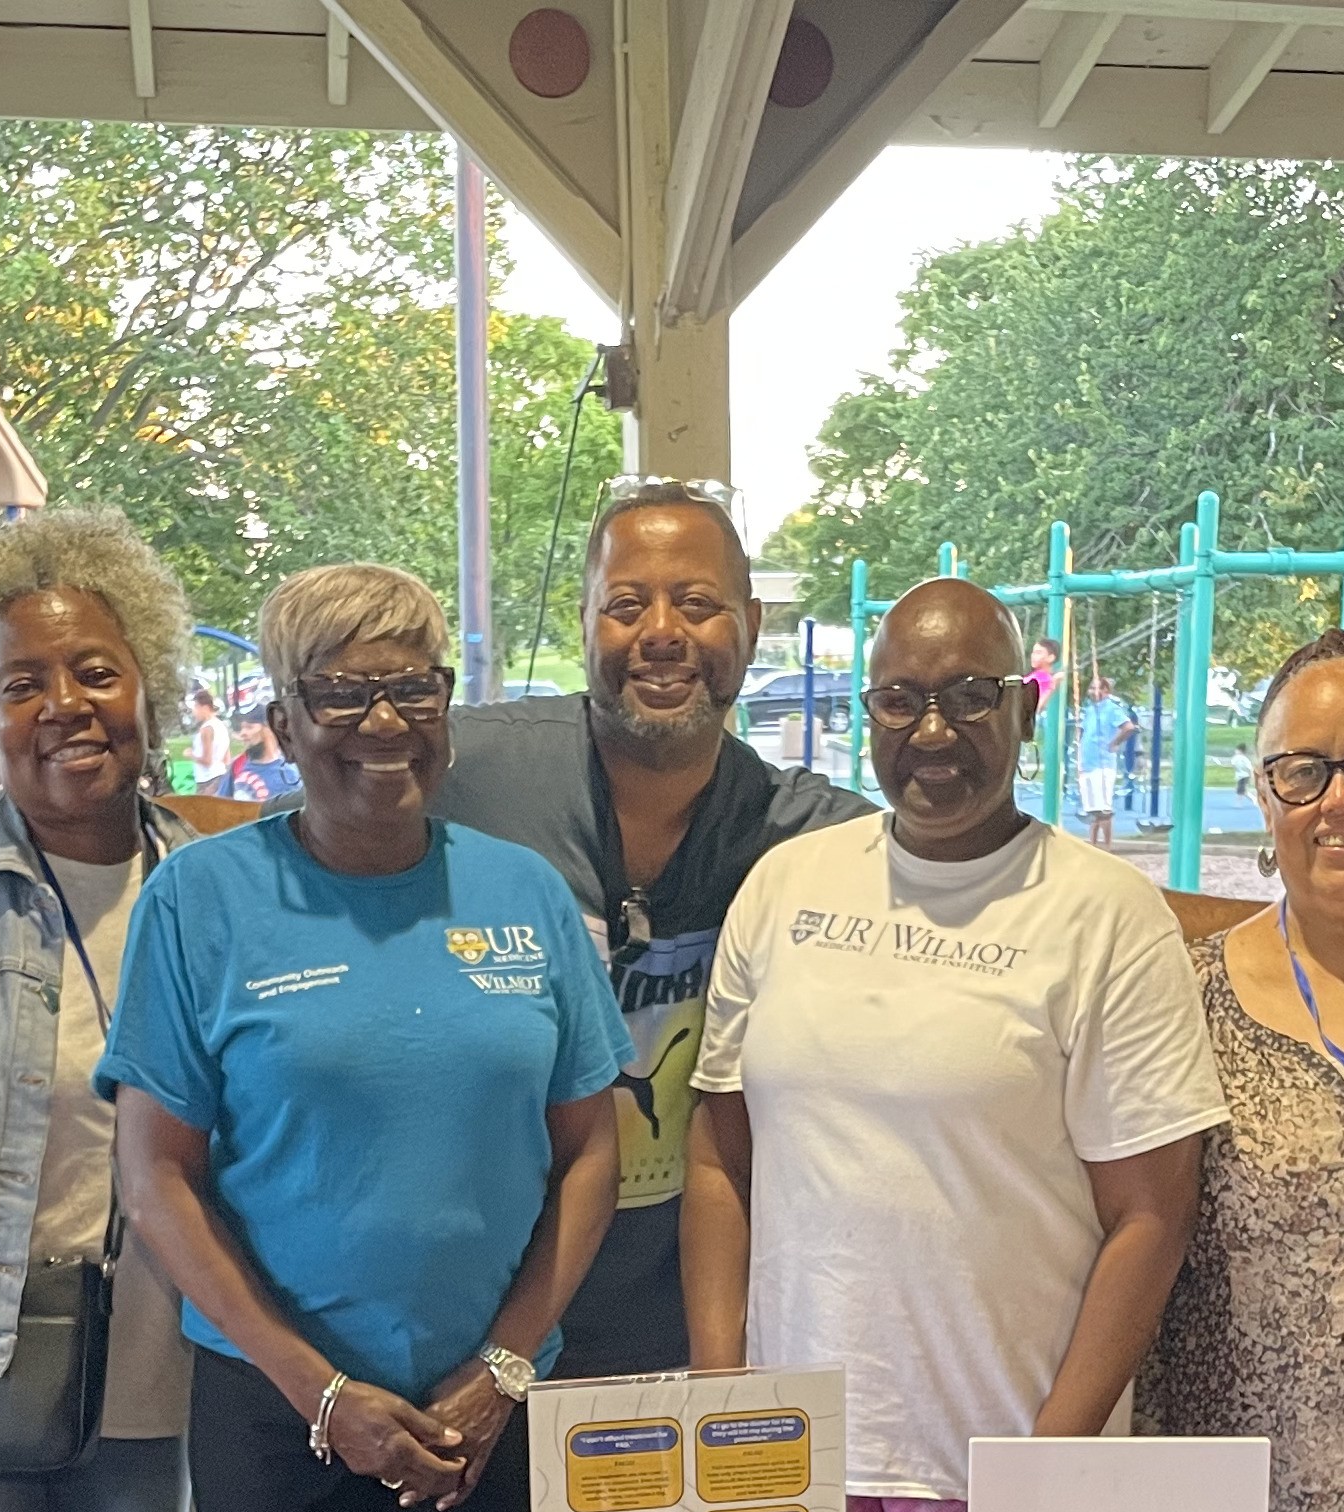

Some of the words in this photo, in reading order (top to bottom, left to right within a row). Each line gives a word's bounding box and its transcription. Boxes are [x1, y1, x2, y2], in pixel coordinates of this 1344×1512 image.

[484, 926, 543, 955] UR
[824, 913, 873, 945] UR
[894, 923, 1027, 969] WILMOT
[893, 953, 938, 965] CANCER
[941, 959, 1004, 977] INSTITUTE
[469, 973, 544, 990] WILMOT
